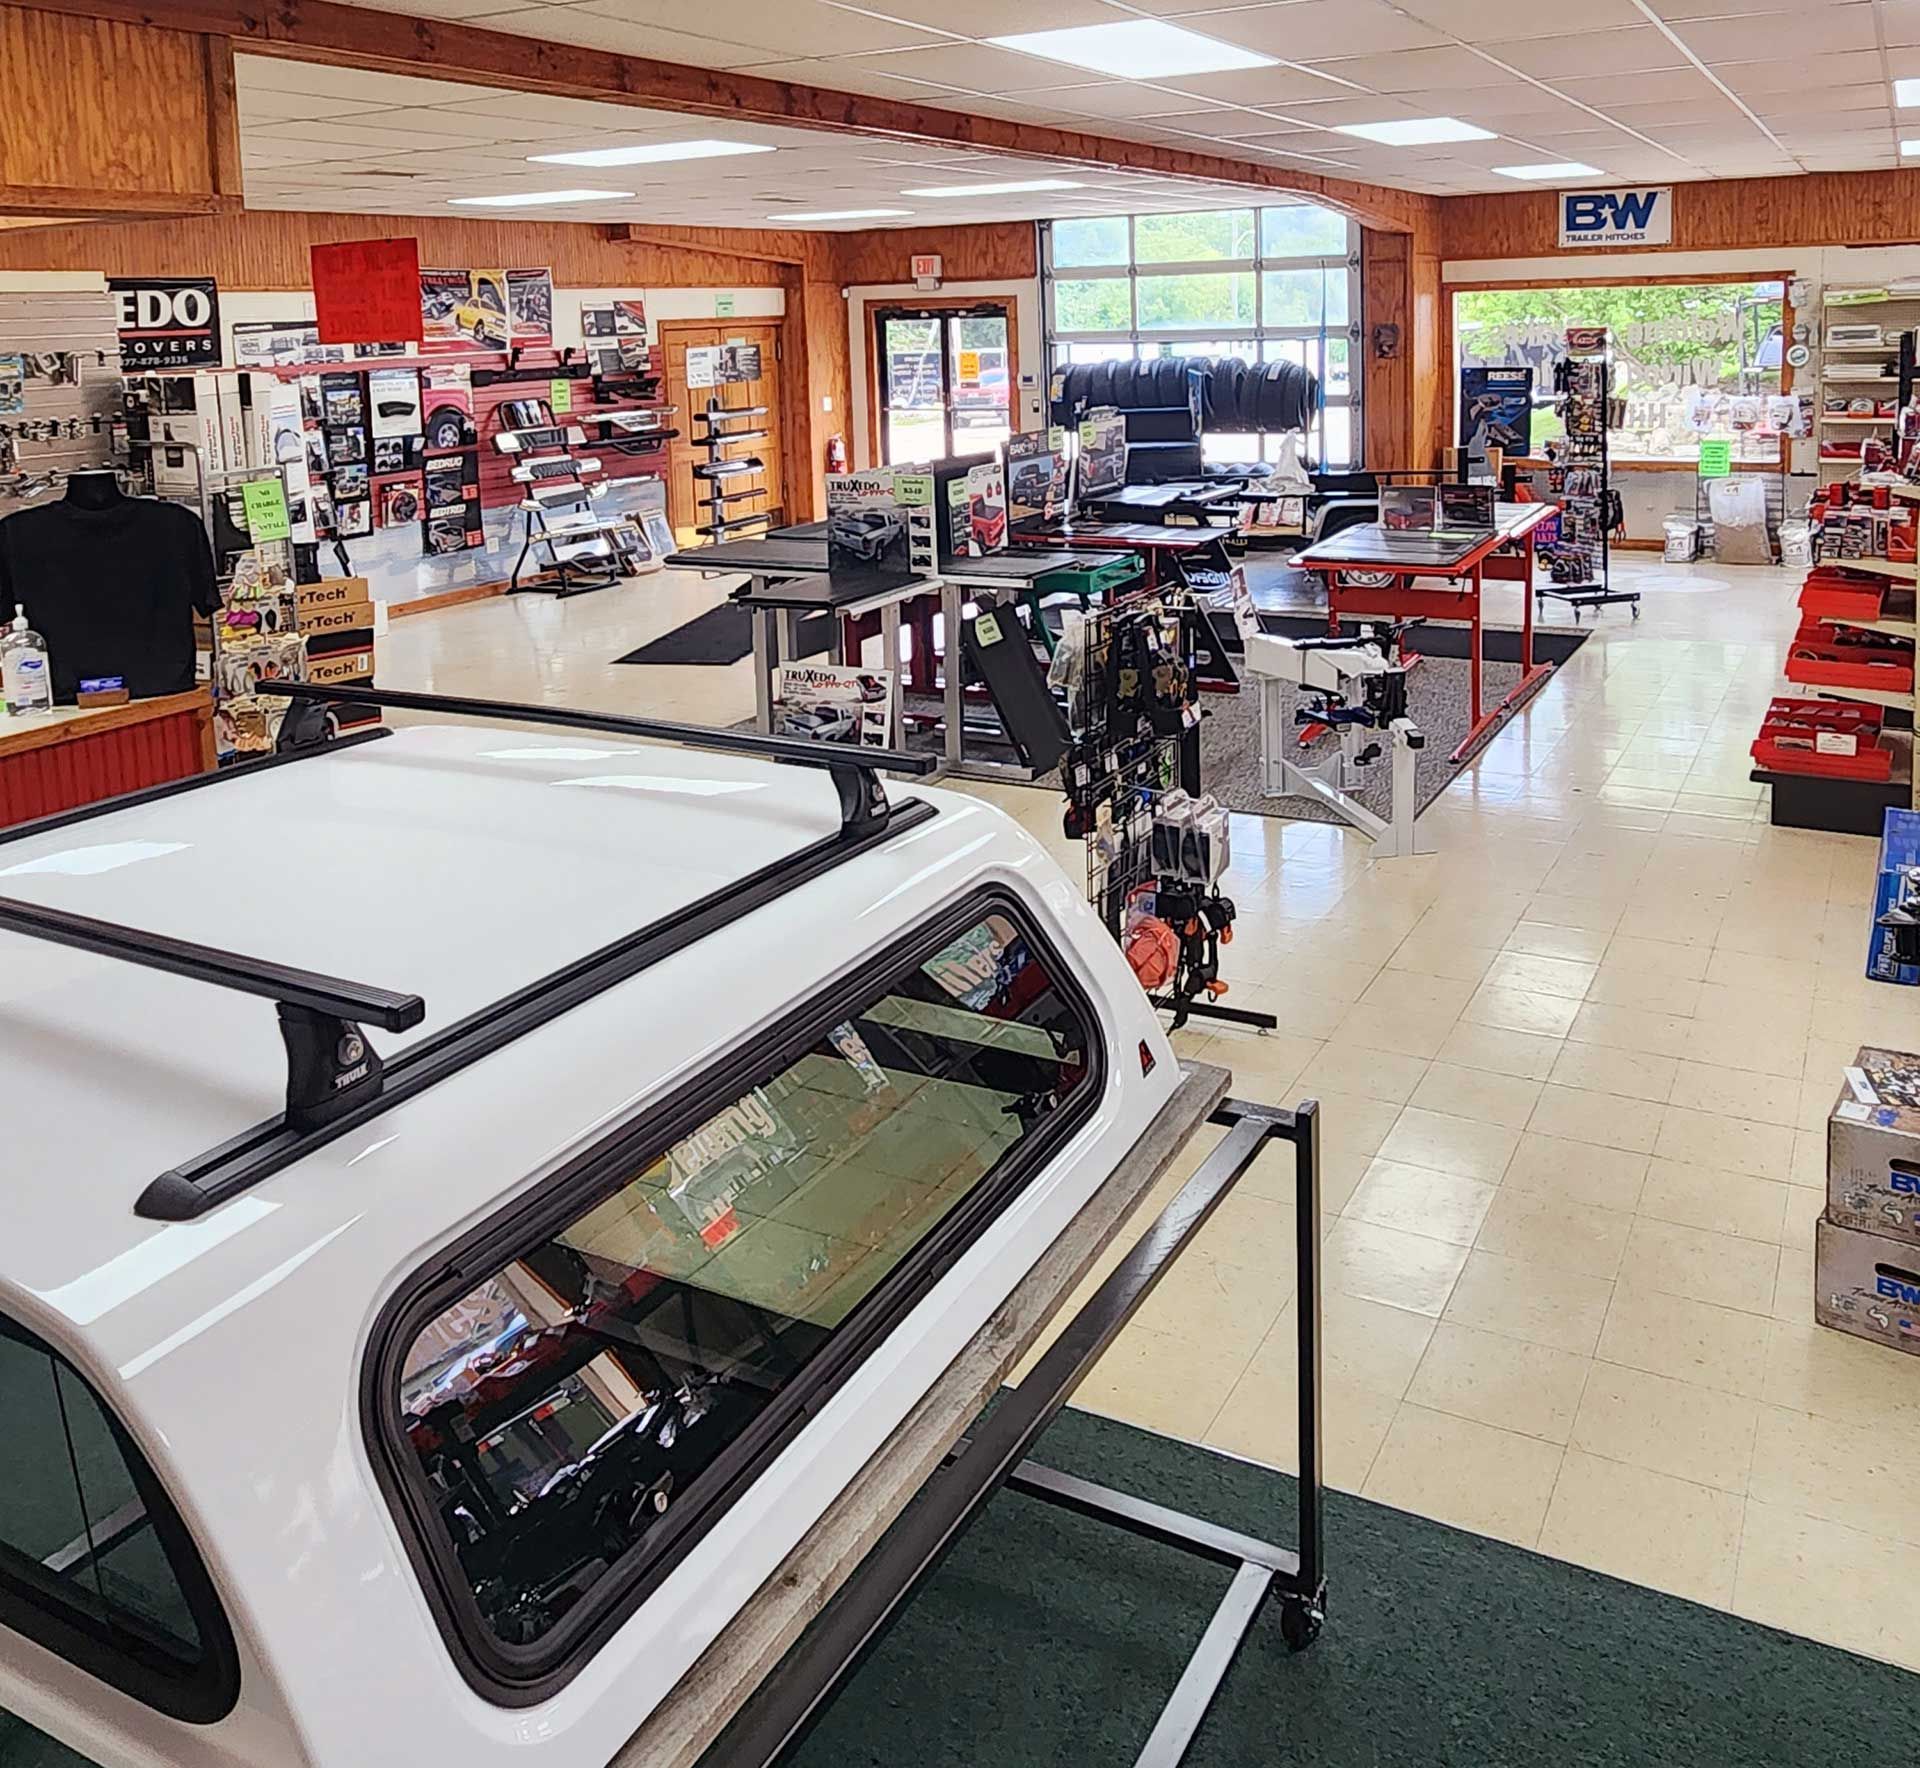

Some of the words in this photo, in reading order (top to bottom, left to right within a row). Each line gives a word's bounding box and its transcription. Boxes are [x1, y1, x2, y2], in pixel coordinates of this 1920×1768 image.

[1566, 233, 1602, 243] TRAILER
[1605, 232, 1646, 242] HITCHES
[119, 339, 213, 354] COVERS
[121, 355, 189, 366] 77-878-9336
[1487, 370, 1525, 381] REESE
[829, 479, 880, 493] TRUXEDO
[251, 499, 281, 510] CHARGE
[262, 511, 274, 519] TO
[785, 669, 837, 683] TRUXEDO
[335, 1062, 370, 1089] THULE
